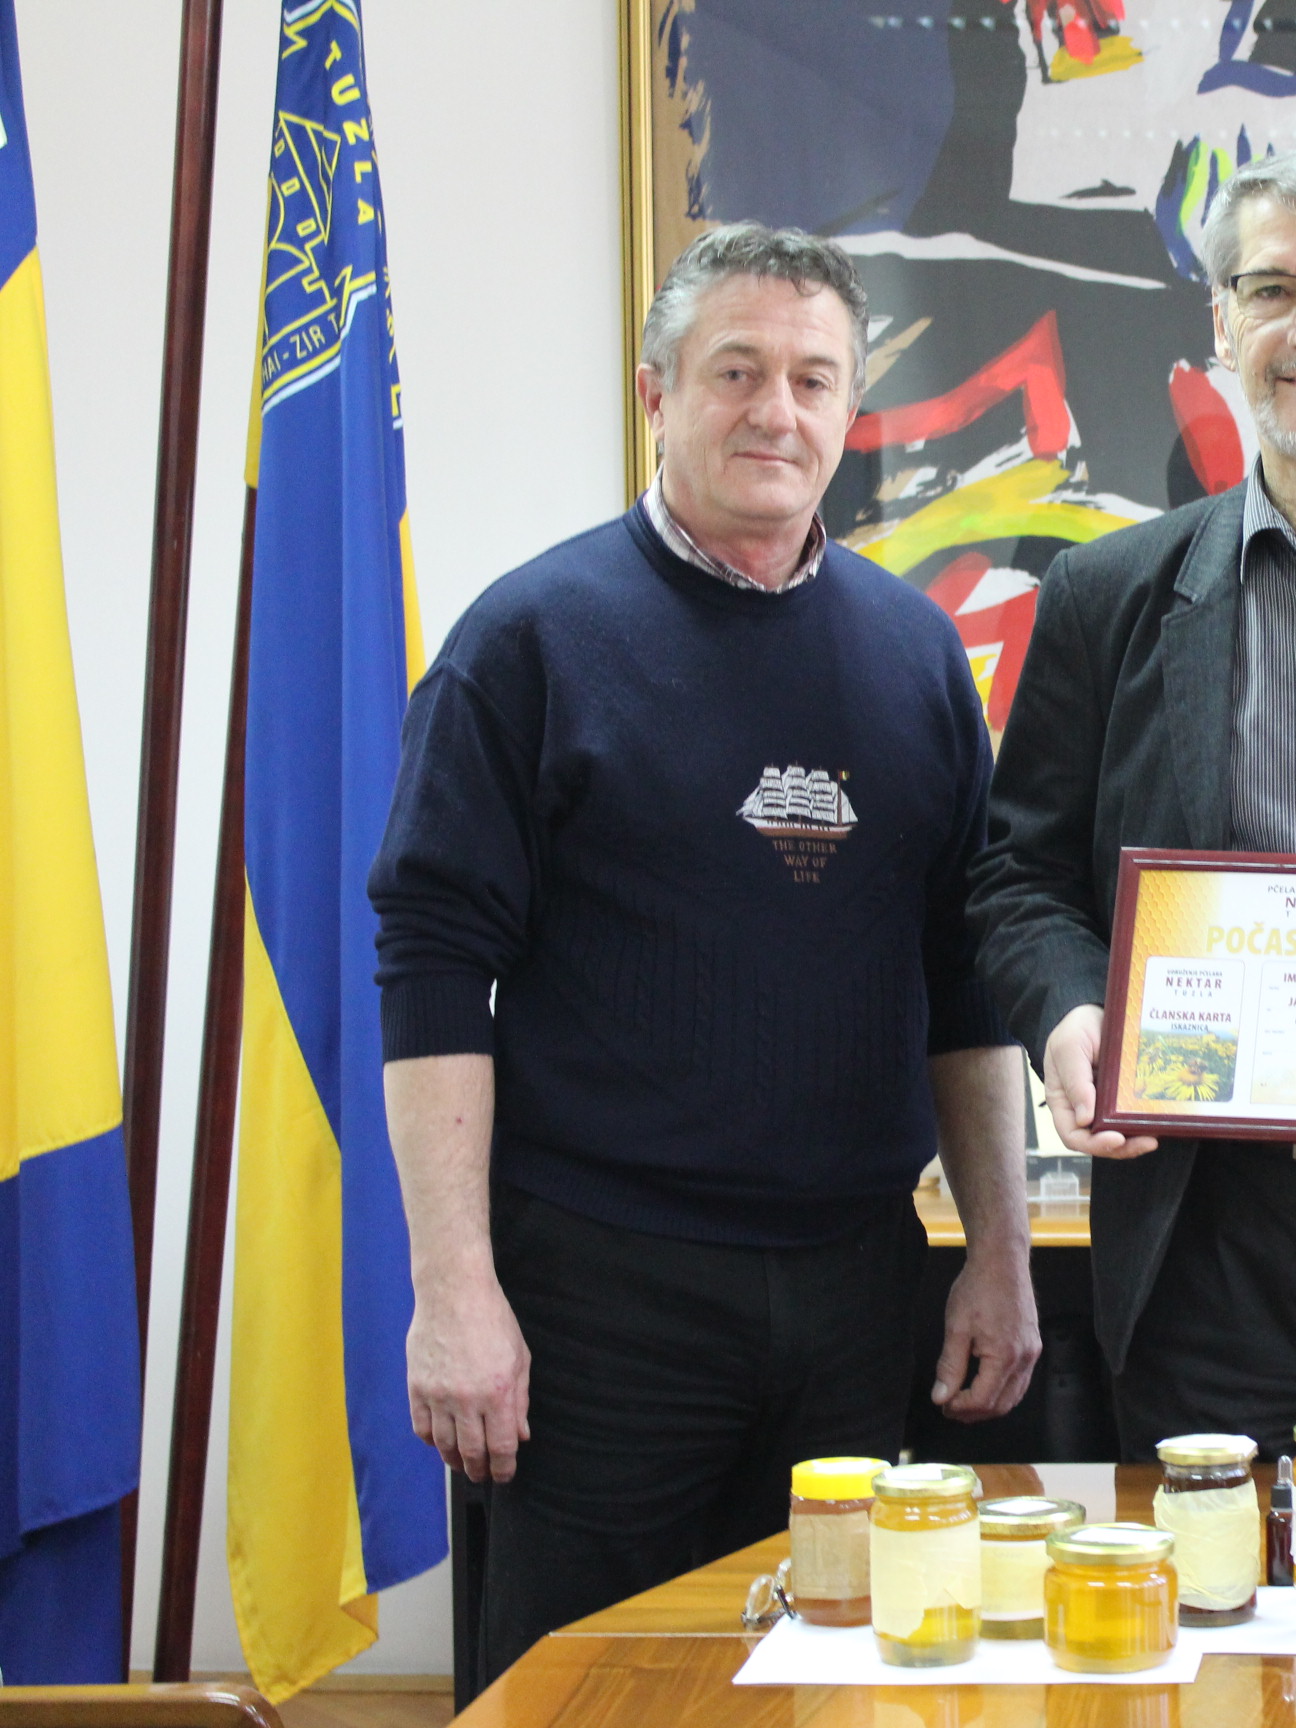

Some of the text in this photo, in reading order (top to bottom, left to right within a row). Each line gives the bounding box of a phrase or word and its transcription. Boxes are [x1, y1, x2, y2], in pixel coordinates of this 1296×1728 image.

[324, 40, 375, 225] TUZLA
[773, 840, 837, 853] THE OTHER
[784, 854, 808, 867] WAY
[1165, 976, 1222, 989] NEKTAR
[1149, 1007, 1232, 1023] ČLANSKA KARTA
[1171, 1023, 1209, 1032] ISKAZNICA
